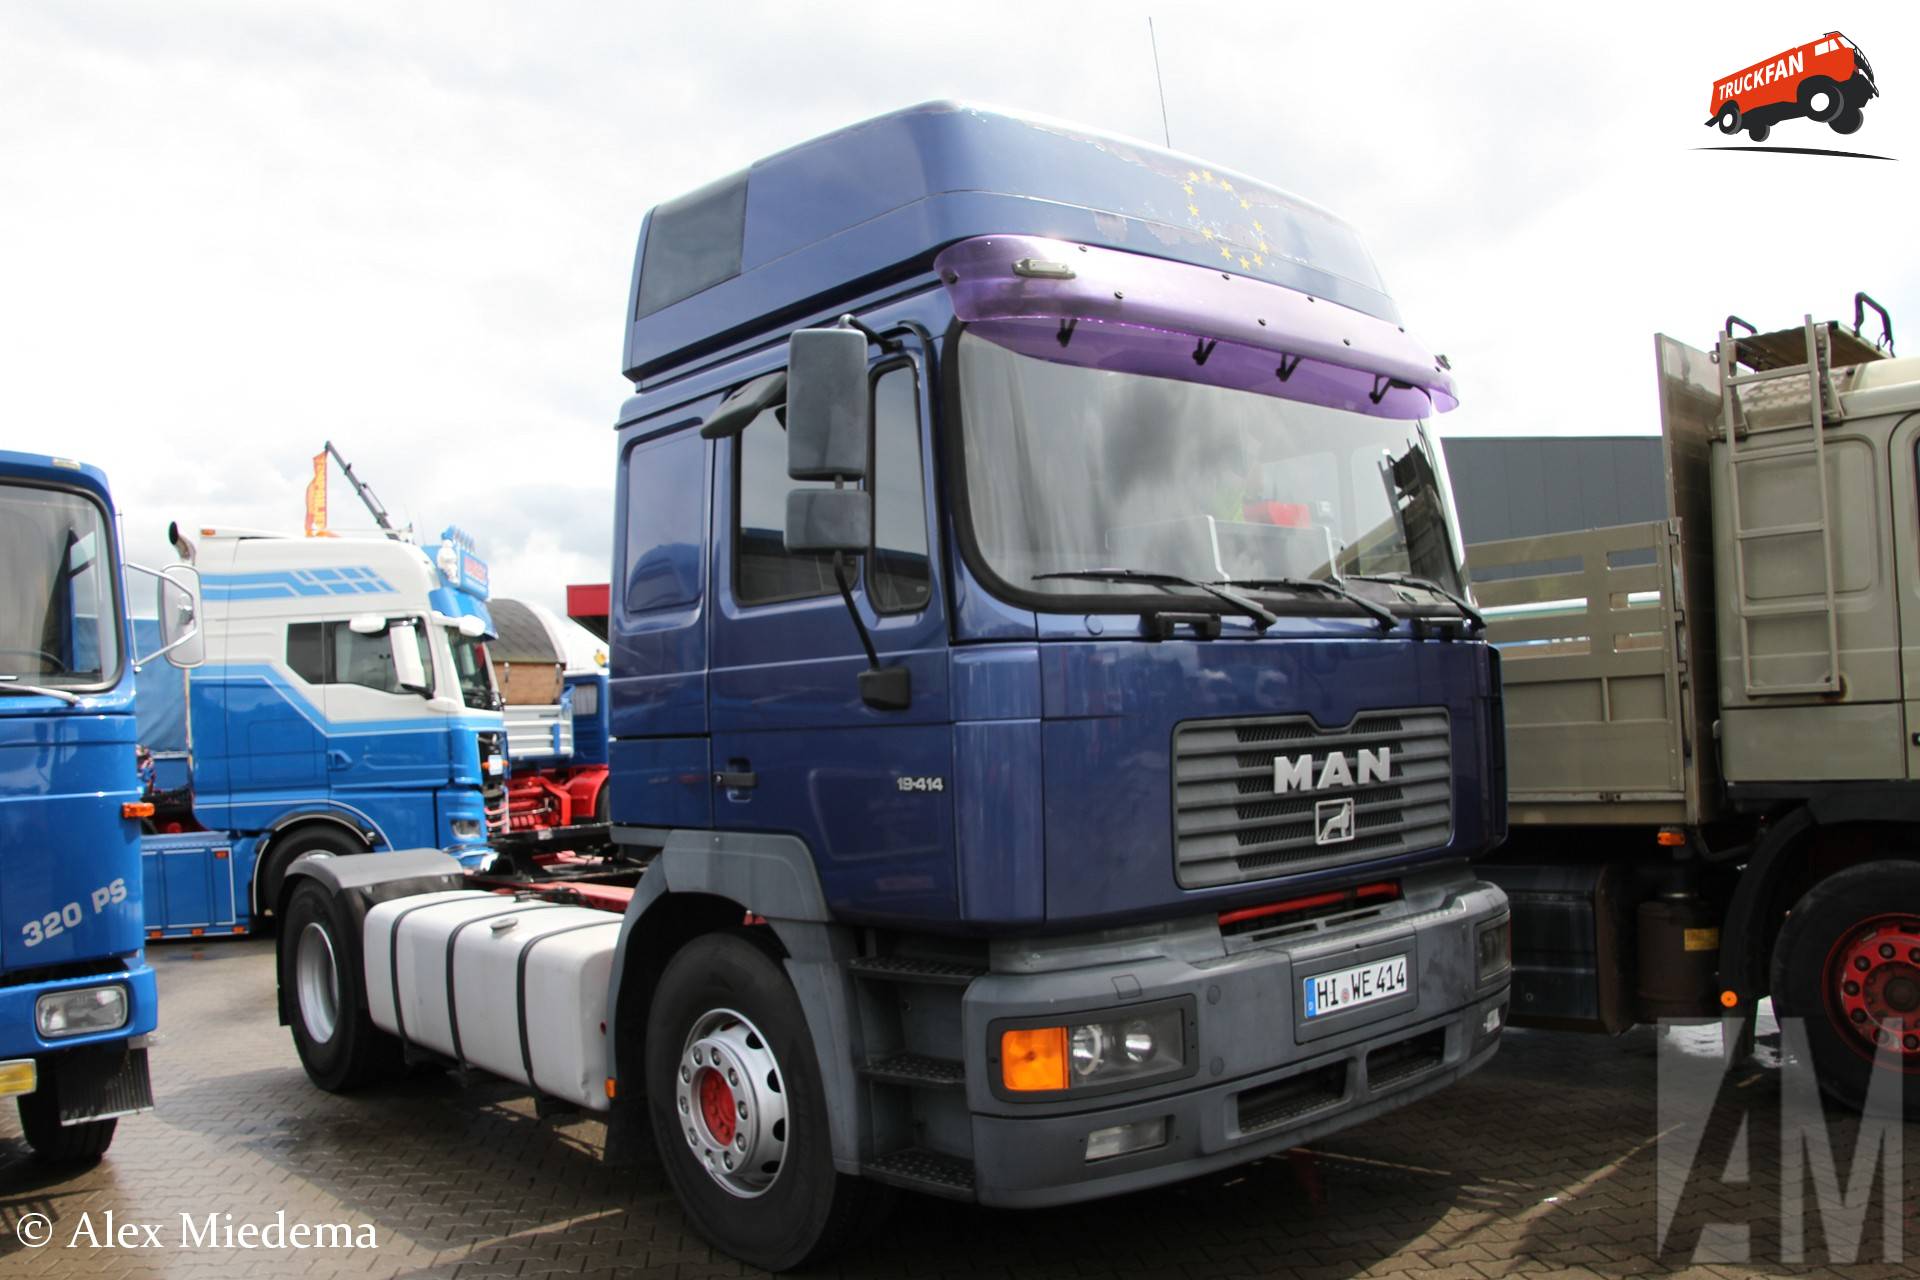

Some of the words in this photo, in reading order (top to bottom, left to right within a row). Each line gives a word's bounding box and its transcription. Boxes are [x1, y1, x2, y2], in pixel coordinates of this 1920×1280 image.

[1274, 747, 1390, 794] MAN
[22, 902, 82, 947] 320
[91, 878, 127, 914] PS
[1317, 979, 1338, 1009] HI
[1351, 970, 1372, 1000] WE
[1376, 962, 1405, 992] 414
